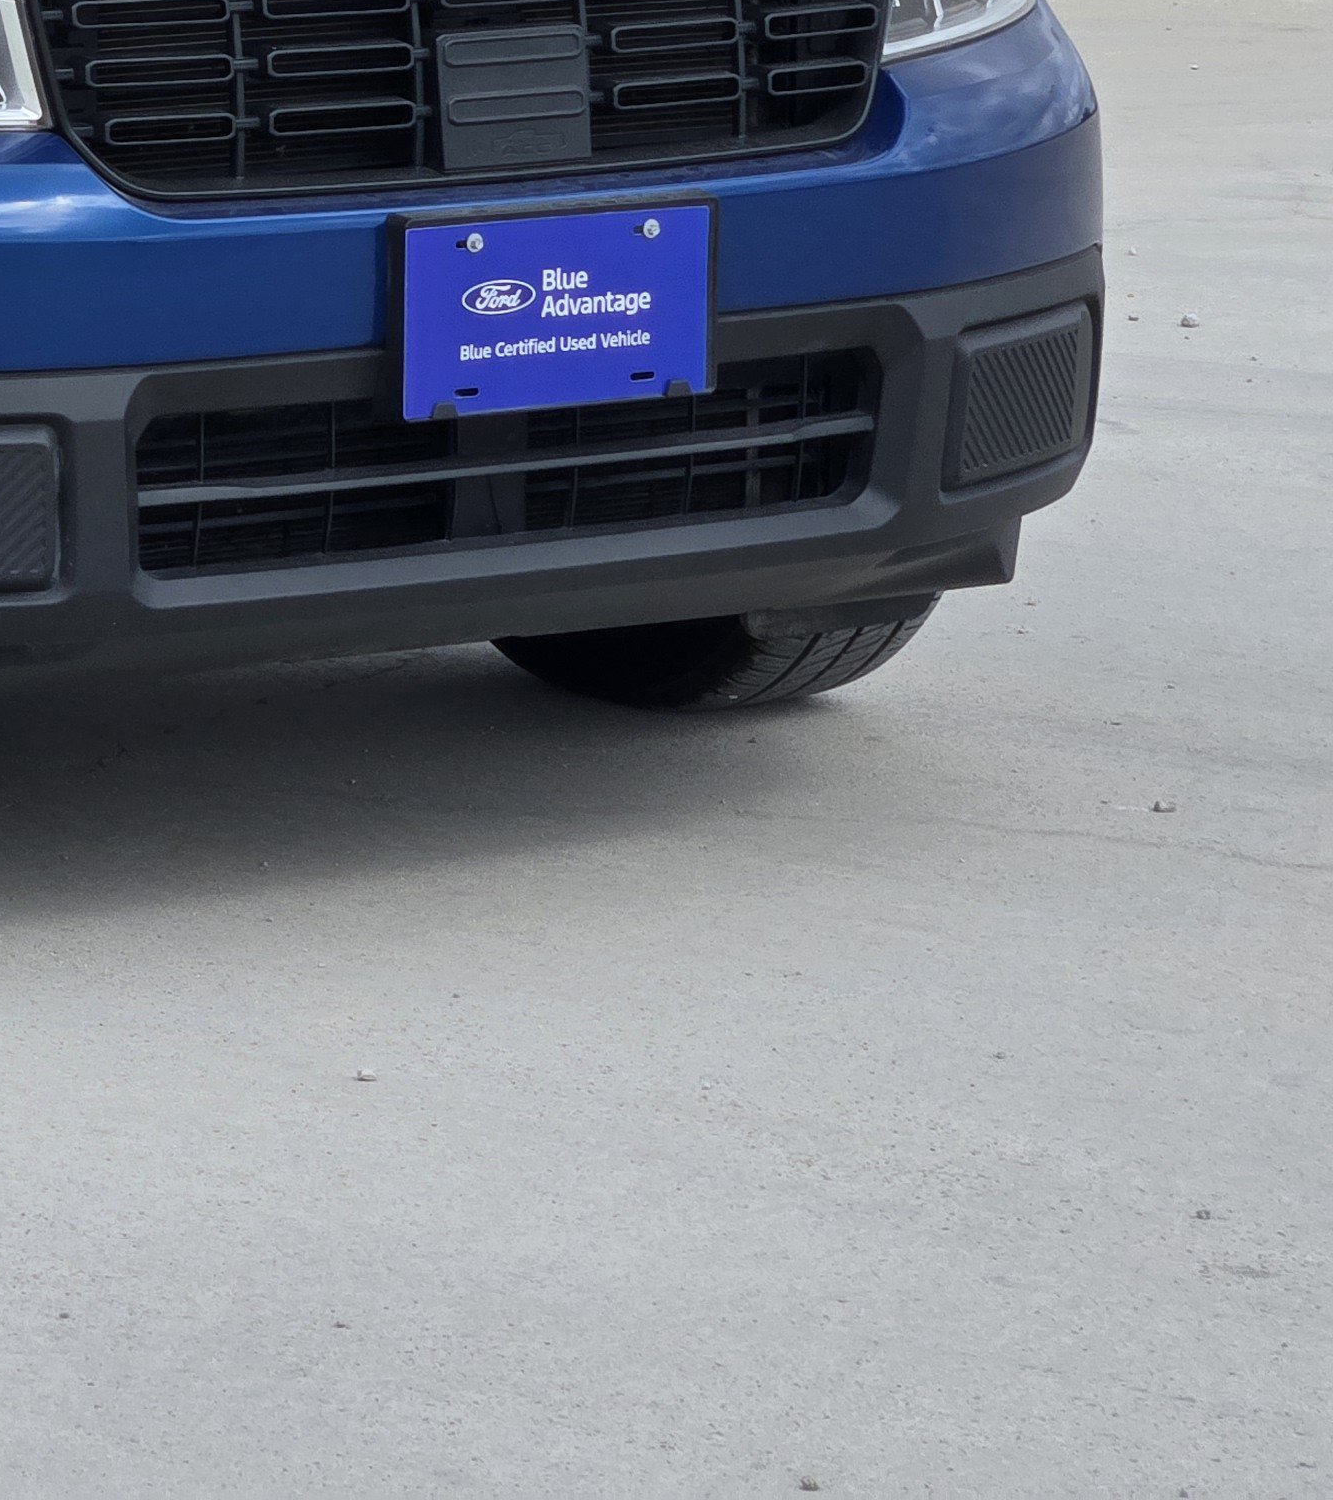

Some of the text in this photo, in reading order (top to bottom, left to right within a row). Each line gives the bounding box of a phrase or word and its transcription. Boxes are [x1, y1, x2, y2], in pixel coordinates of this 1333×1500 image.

[542, 267, 589, 291] Blue
[475, 284, 522, 310] Ford
[541, 291, 651, 318] Advantage
[459, 329, 651, 361] Blue Certified Used Vehicle
